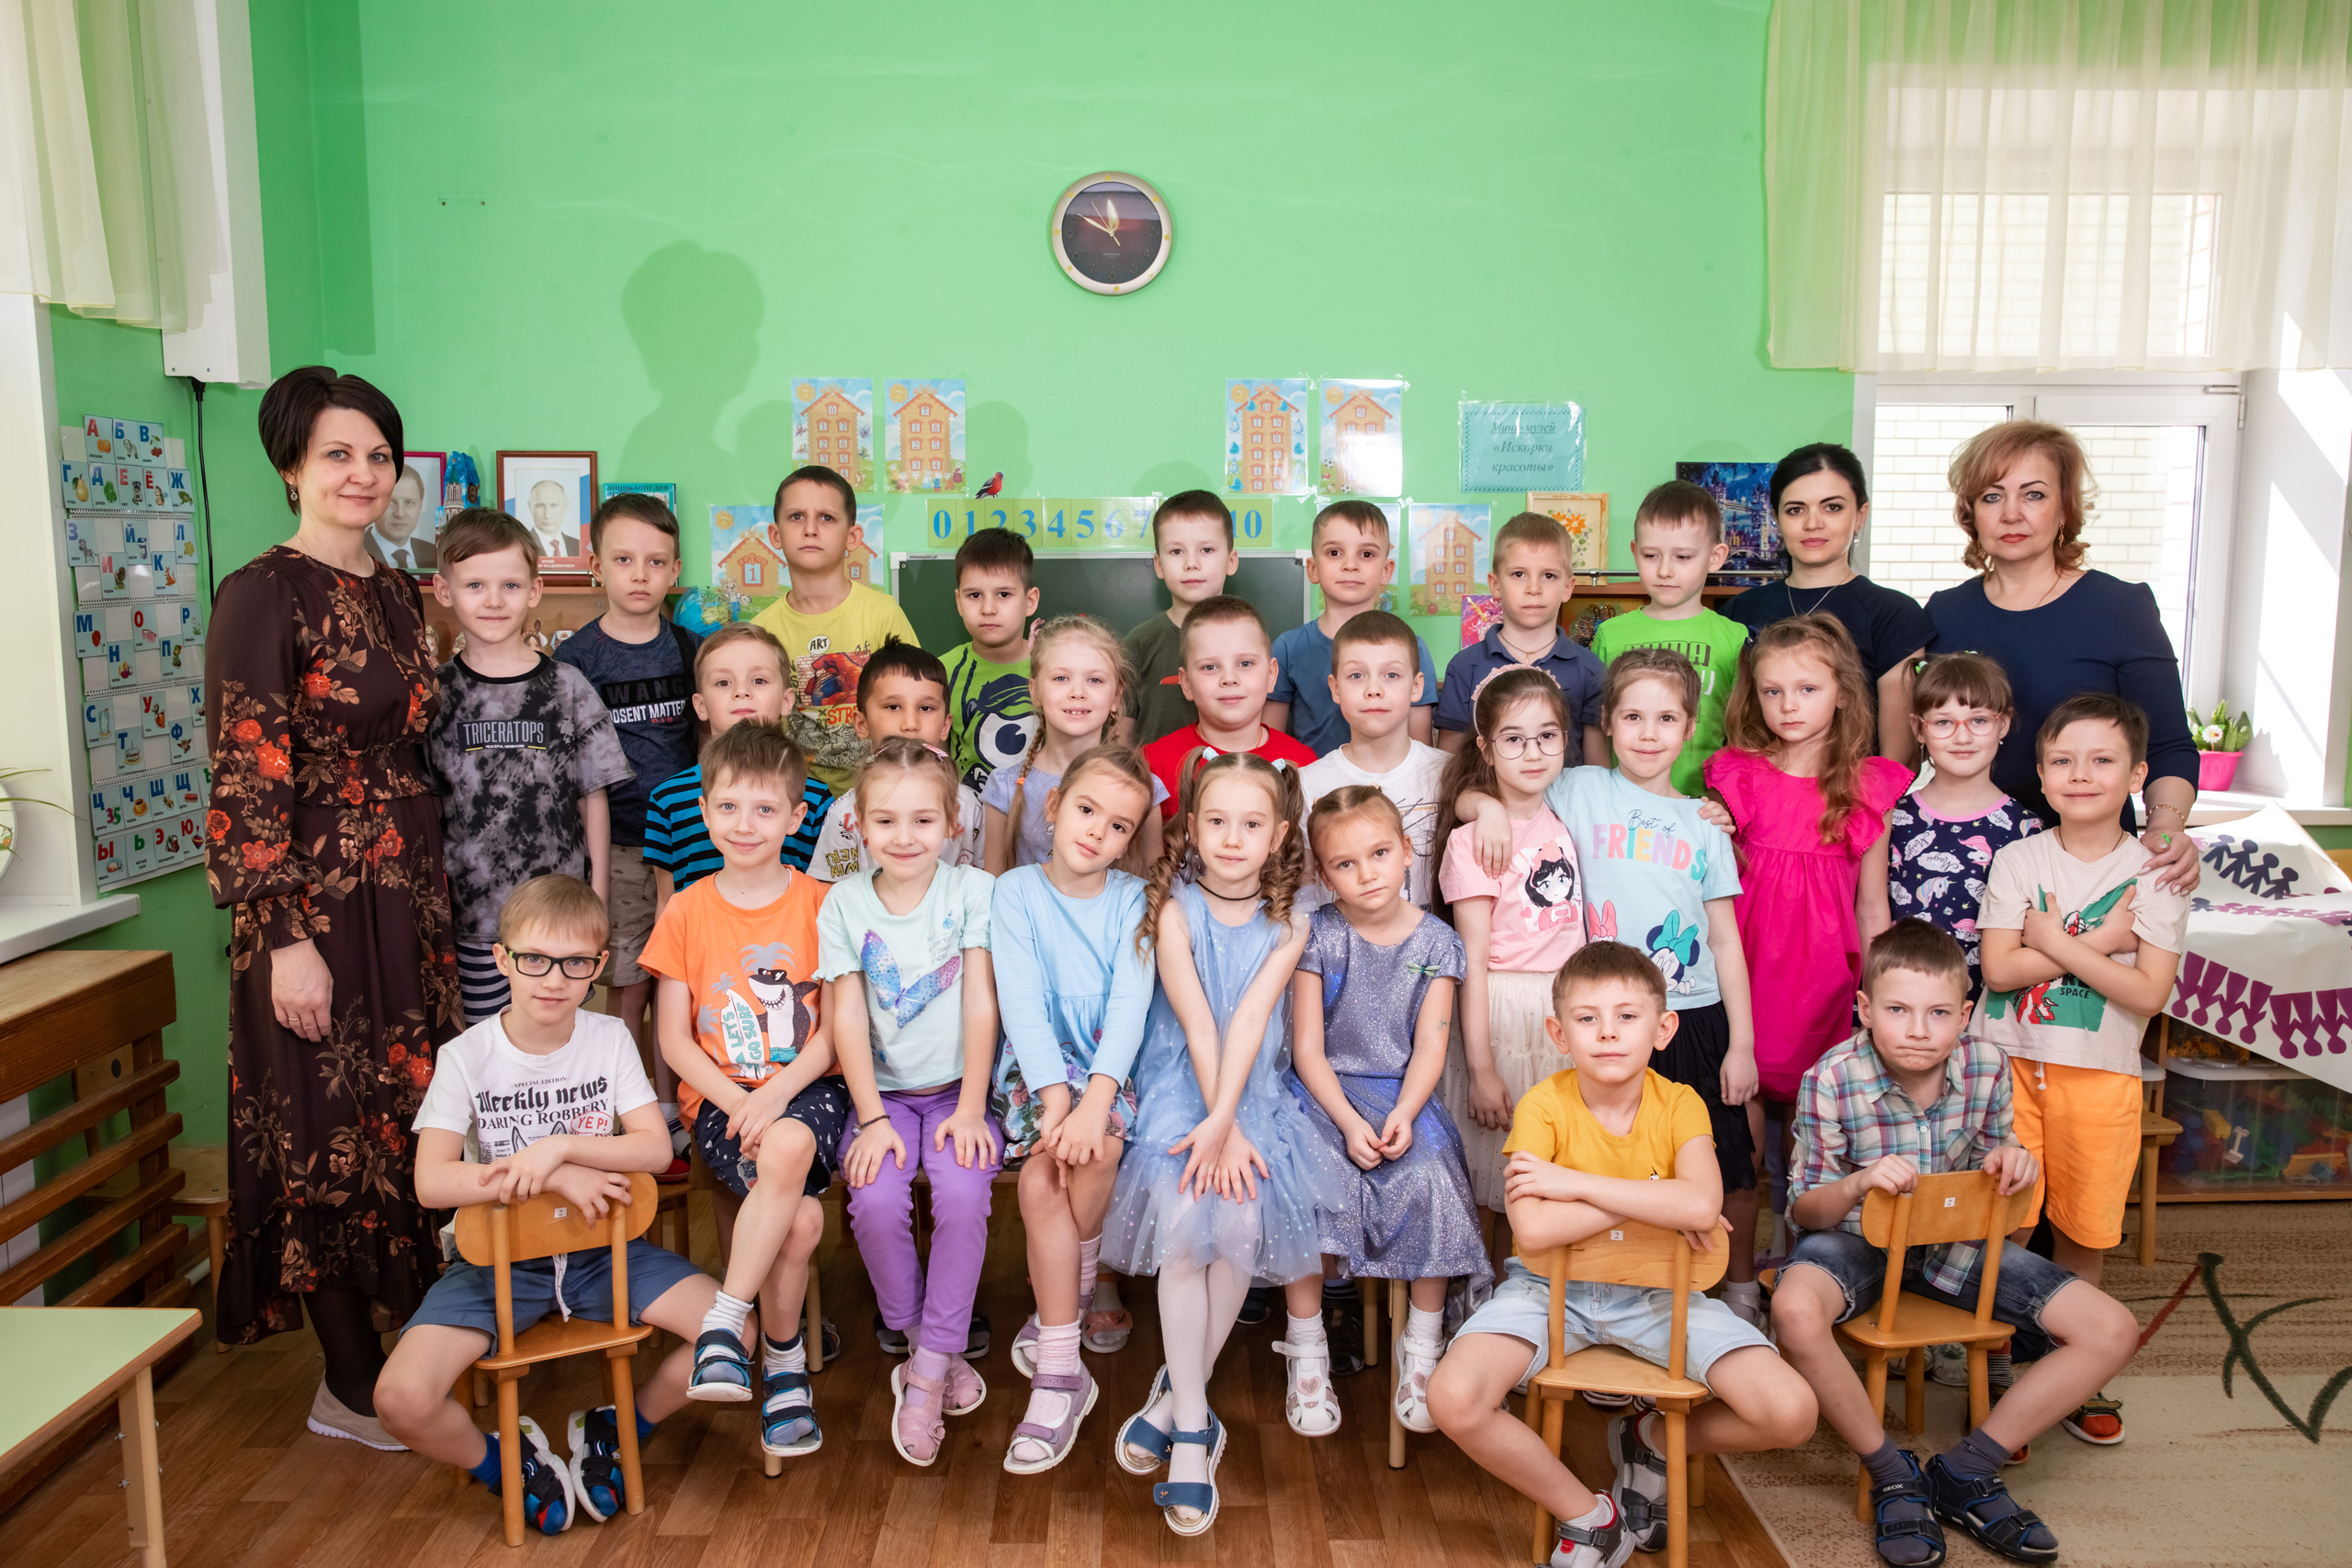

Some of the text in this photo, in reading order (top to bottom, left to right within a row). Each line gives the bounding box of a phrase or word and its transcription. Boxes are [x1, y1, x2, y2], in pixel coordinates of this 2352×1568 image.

[1065, 229, 1074, 240] 9
[1149, 226, 1158, 238] 3
[1072, 250, 1080, 261] 8
[1144, 247, 1150, 259] 4
[1089, 263, 1096, 275] 7
[1108, 269, 1117, 280] 6
[1130, 262, 1138, 274] 5
[922, 407, 928, 415] 7
[1358, 409, 1364, 417] 9
[87, 419, 99, 437] А
[115, 422, 125, 439] Б
[140, 425, 150, 442] В
[841, 423, 846, 431] 7
[933, 423, 939, 432] 6
[1368, 425, 1374, 434] 8
[820, 440, 826, 448] 2
[841, 440, 846, 448] 6
[913, 441, 919, 449] 2
[933, 441, 938, 449] 5
[1255, 434, 1260, 443] 2
[1255, 451, 1261, 459] 3
[1494, 441, 1553, 455] «Искорки
[821, 455, 827, 463] 3
[842, 455, 847, 463] 5
[913, 461, 919, 469] 3
[933, 461, 939, 469] 4
[62, 465, 72, 482] Г
[92, 467, 104, 486] Д
[842, 469, 847, 478] 4
[1255, 467, 1260, 475] 4
[1491, 463, 1554, 475] красоты»
[119, 468, 129, 486] Е
[145, 470, 154, 490] Ё
[171, 472, 185, 489] Ж
[68, 523, 78, 540] З
[933, 510, 952, 539] 0
[964, 510, 975, 536] 1
[990, 509, 1007, 529] 2
[1020, 509, 1036, 538] 3
[1047, 510, 1066, 538] 4
[1077, 510, 1094, 538] 5
[1105, 509, 1124, 538] 6
[1134, 509, 1152, 538] 7
[125, 524, 136, 543] Й
[176, 525, 185, 540] Л
[1458, 547, 1464, 556] 5
[102, 556, 113, 573] И
[154, 555, 164, 570] К
[1437, 565, 1443, 573] 2
[1457, 565, 1463, 573] 4
[1438, 584, 1443, 592] 3
[1457, 584, 1463, 592] 3
[134, 611, 143, 627] О
[182, 608, 190, 624] Р
[76, 615, 93, 633] М
[162, 640, 171, 657] П
[809, 637, 828, 651] ART
[109, 645, 120, 663] Н
[191, 687, 201, 704] Х
[142, 696, 153, 714] У
[86, 705, 96, 723] С
[171, 723, 183, 740] Ф
[463, 720, 544, 746] TRICERATOPS
[118, 732, 128, 750] Т
[150, 779, 164, 797] Ш
[175, 773, 191, 792] Щ
[122, 785, 134, 803] Ч
[93, 793, 105, 811] Ц
[1628, 808, 1676, 839] Best of
[1894, 814, 1910, 823] agic
[1989, 812, 2010, 826] agic
[181, 818, 194, 837] Ю
[134, 834, 145, 852] Ь
[155, 829, 164, 845] Э
[97, 840, 114, 861] Ы
[1593, 823, 1707, 881] FRIENDS
[1927, 855, 1959, 873] Magic
[2060, 987, 2090, 999] SPACE
[721, 1010, 743, 1048] LET'S
[737, 1002, 763, 1060] GO SURF
[541, 1077, 567, 1085] EDITION
[475, 1076, 607, 1113] Weekly news
[478, 1099, 608, 1130] DARING ROBBERY
[577, 1116, 608, 1131] YEP!
[1883, 1483, 1904, 1492] GEOX
